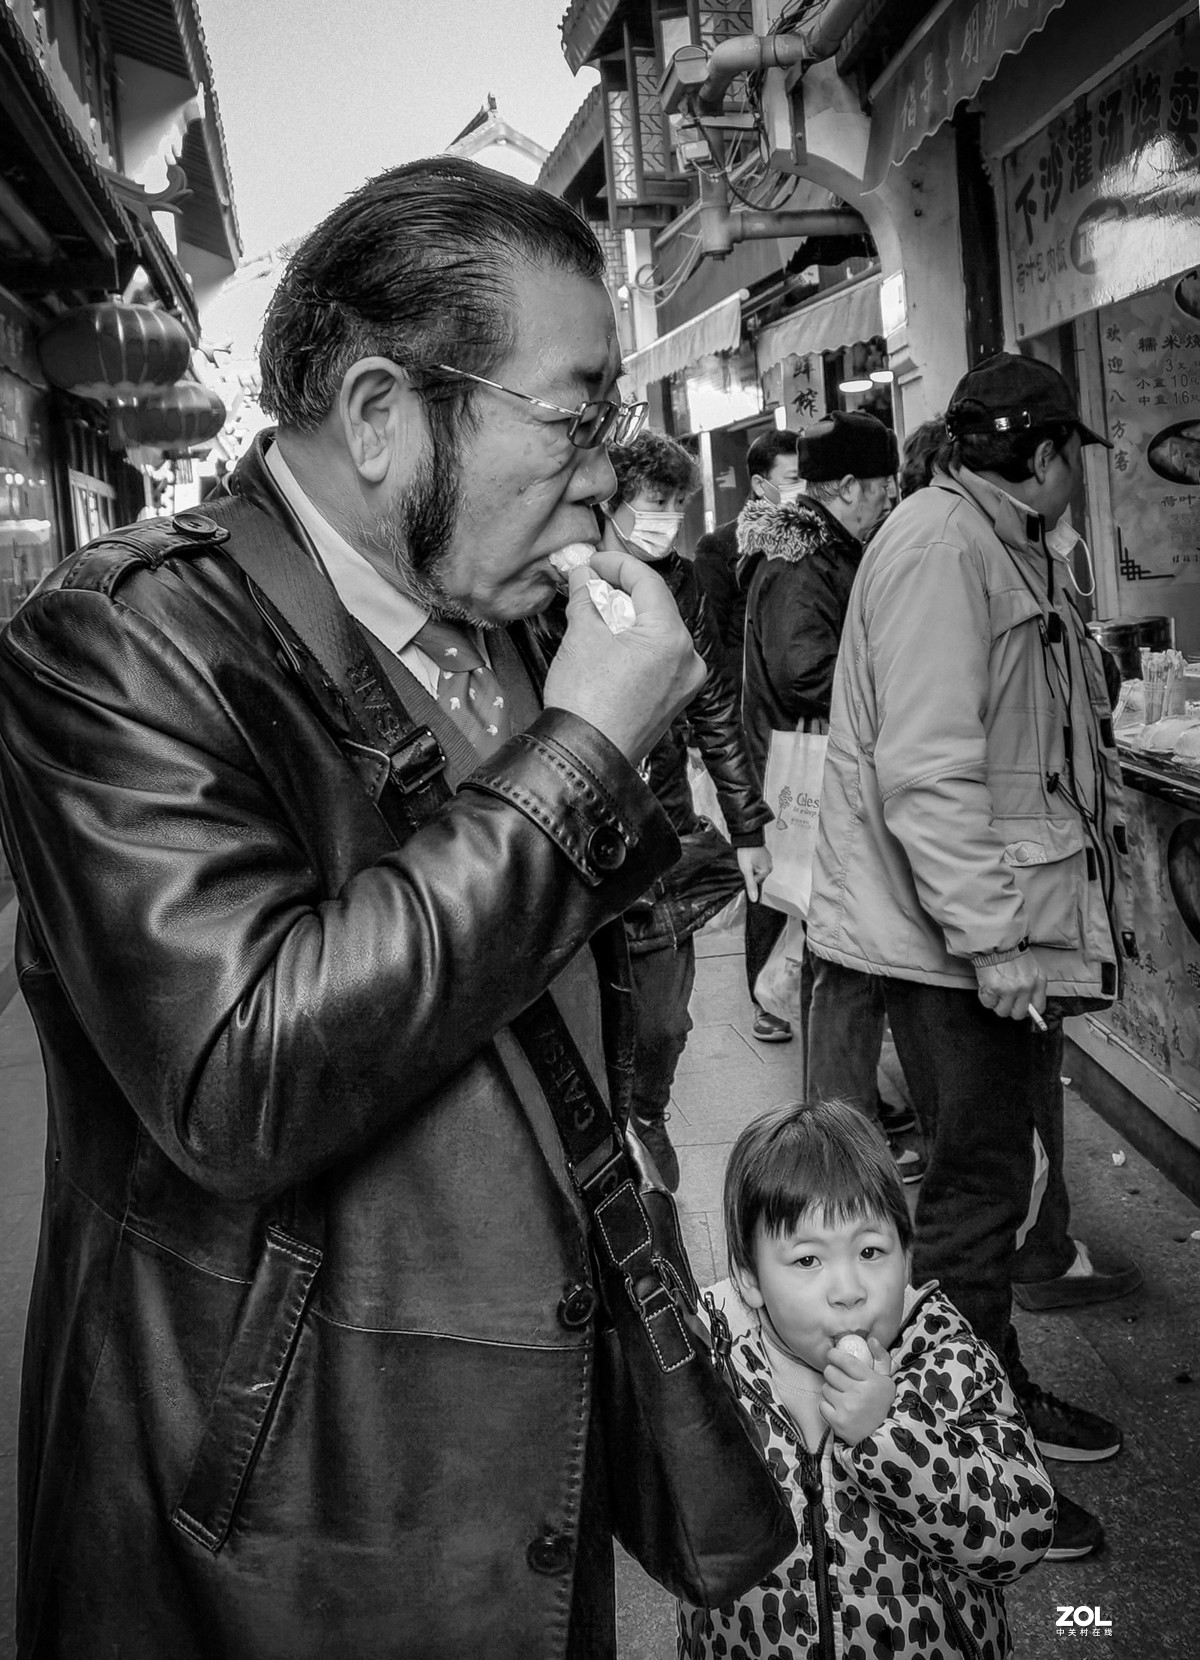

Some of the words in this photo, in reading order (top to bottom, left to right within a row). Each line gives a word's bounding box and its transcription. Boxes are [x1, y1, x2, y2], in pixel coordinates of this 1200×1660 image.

[1106, 323, 1130, 473] 欢迎八方客
